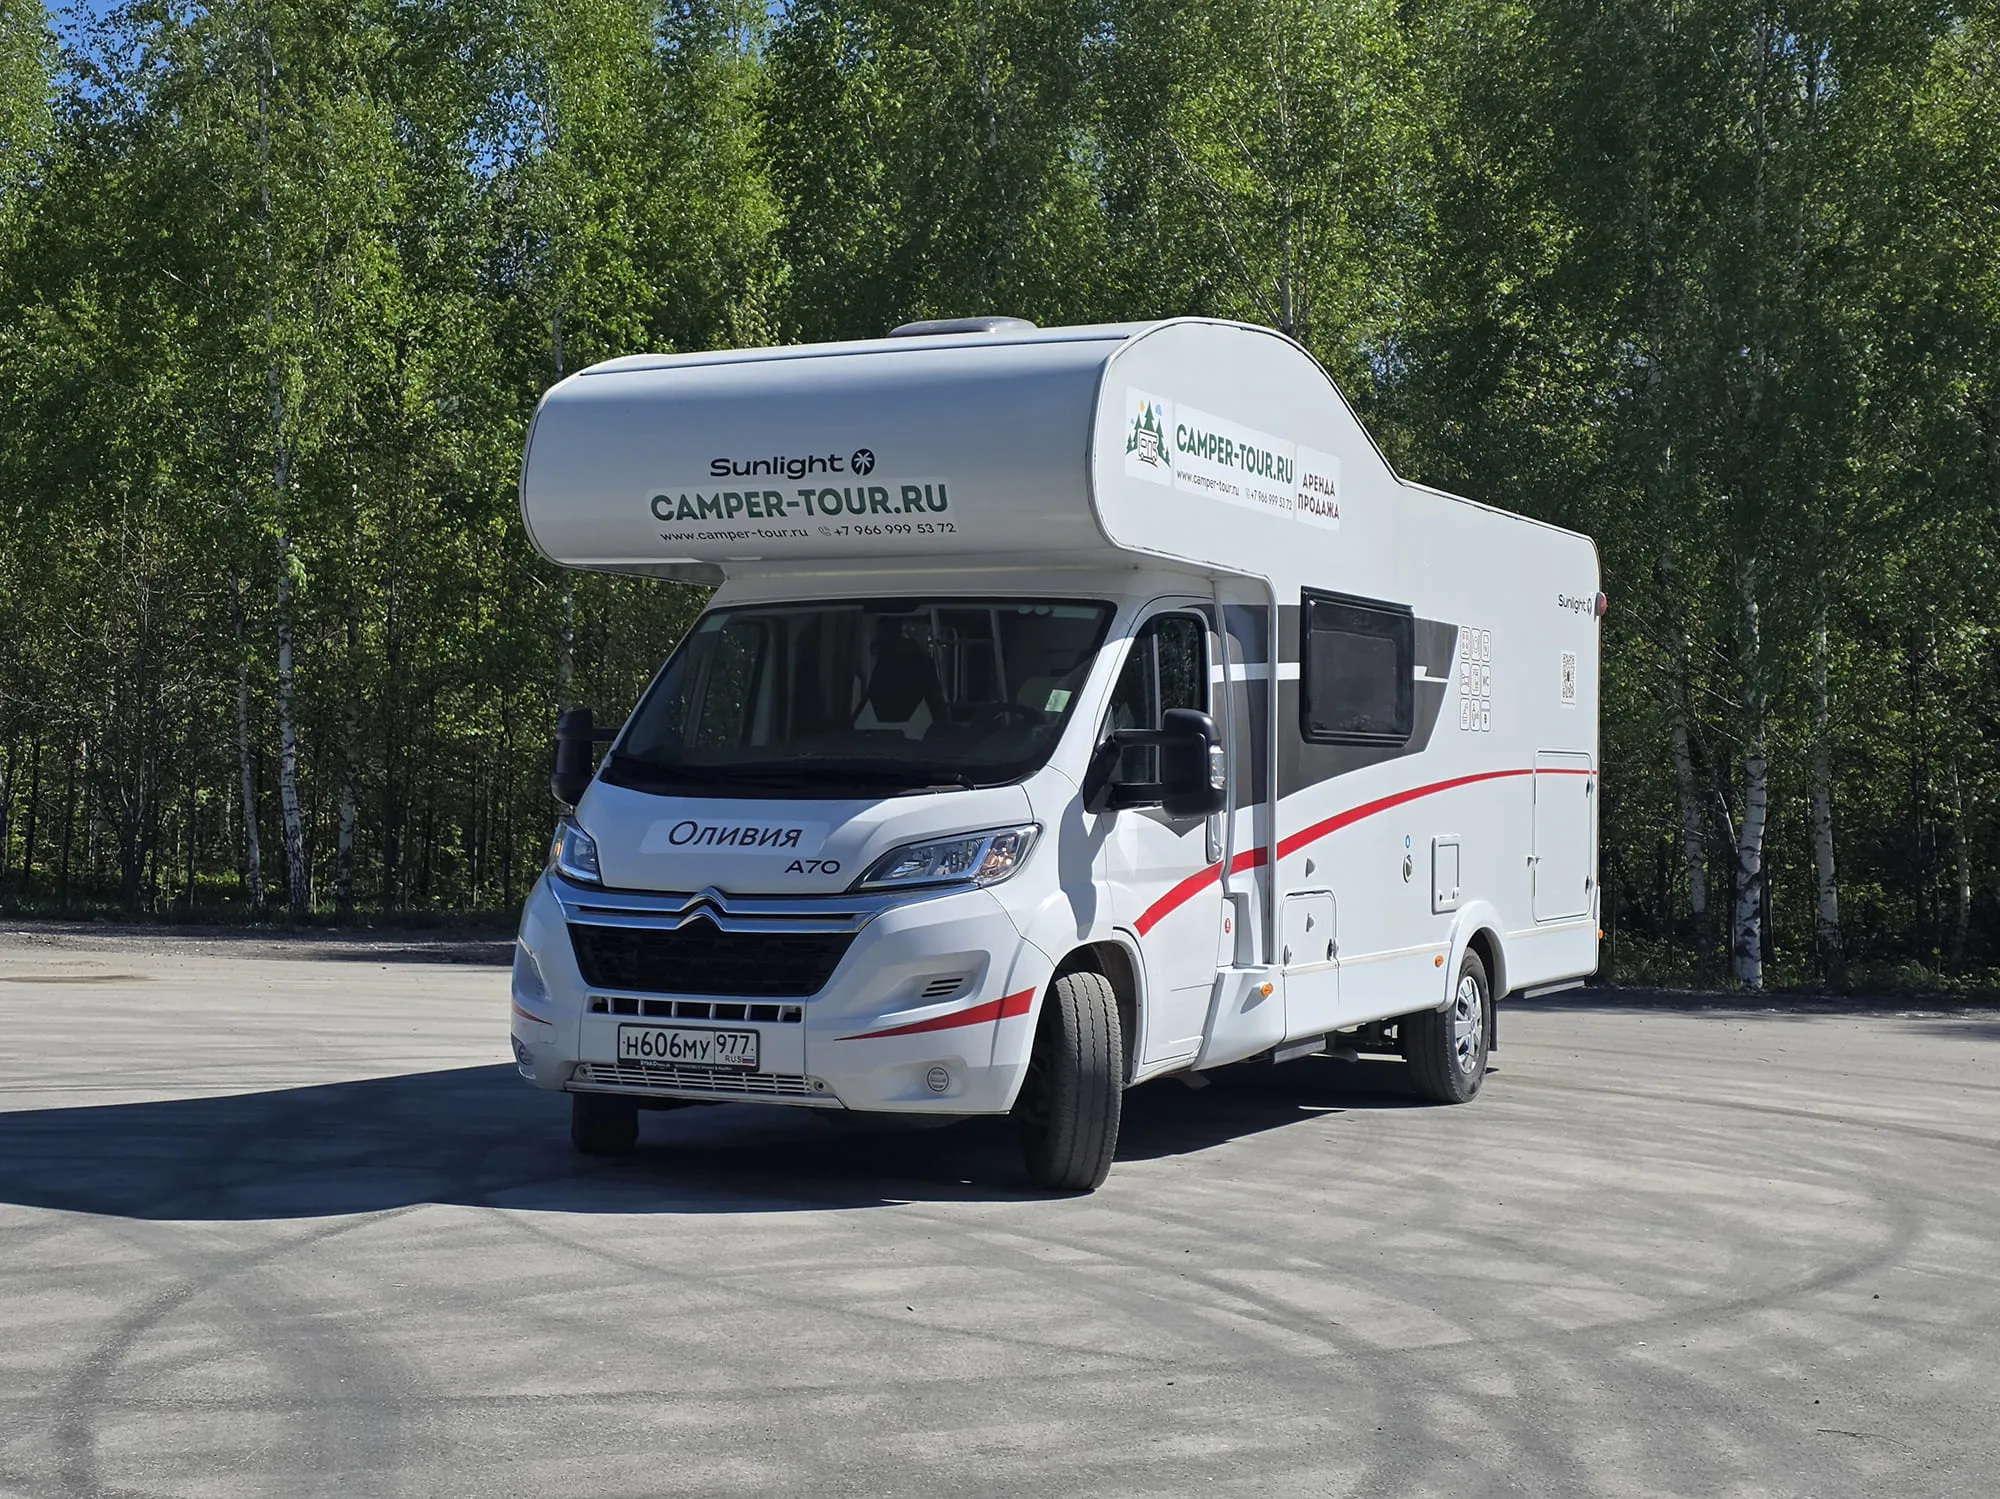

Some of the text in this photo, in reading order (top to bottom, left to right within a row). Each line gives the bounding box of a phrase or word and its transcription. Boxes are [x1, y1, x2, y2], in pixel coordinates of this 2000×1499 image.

[1176, 423, 1293, 485] CAMPER-TOUR.RU
[710, 453, 844, 480] Sunlight
[1176, 470, 1240, 497] www.camper-tour.ru
[1269, 492, 1278, 506] 999
[1286, 498, 1292, 510] 72
[1302, 472, 1336, 496] АРЕНДА
[651, 484, 949, 521] CAMPER-TOUR.RU
[1298, 493, 1340, 520] ПРОДАЖА
[660, 522, 956, 542] www.camper-tour.ru +7 966 999 53 72
[1558, 594, 1586, 614] Sunlight
[784, 859, 841, 874] A70
[716, 1034, 750, 1054] 977
[725, 1055, 742, 1063] RUS
